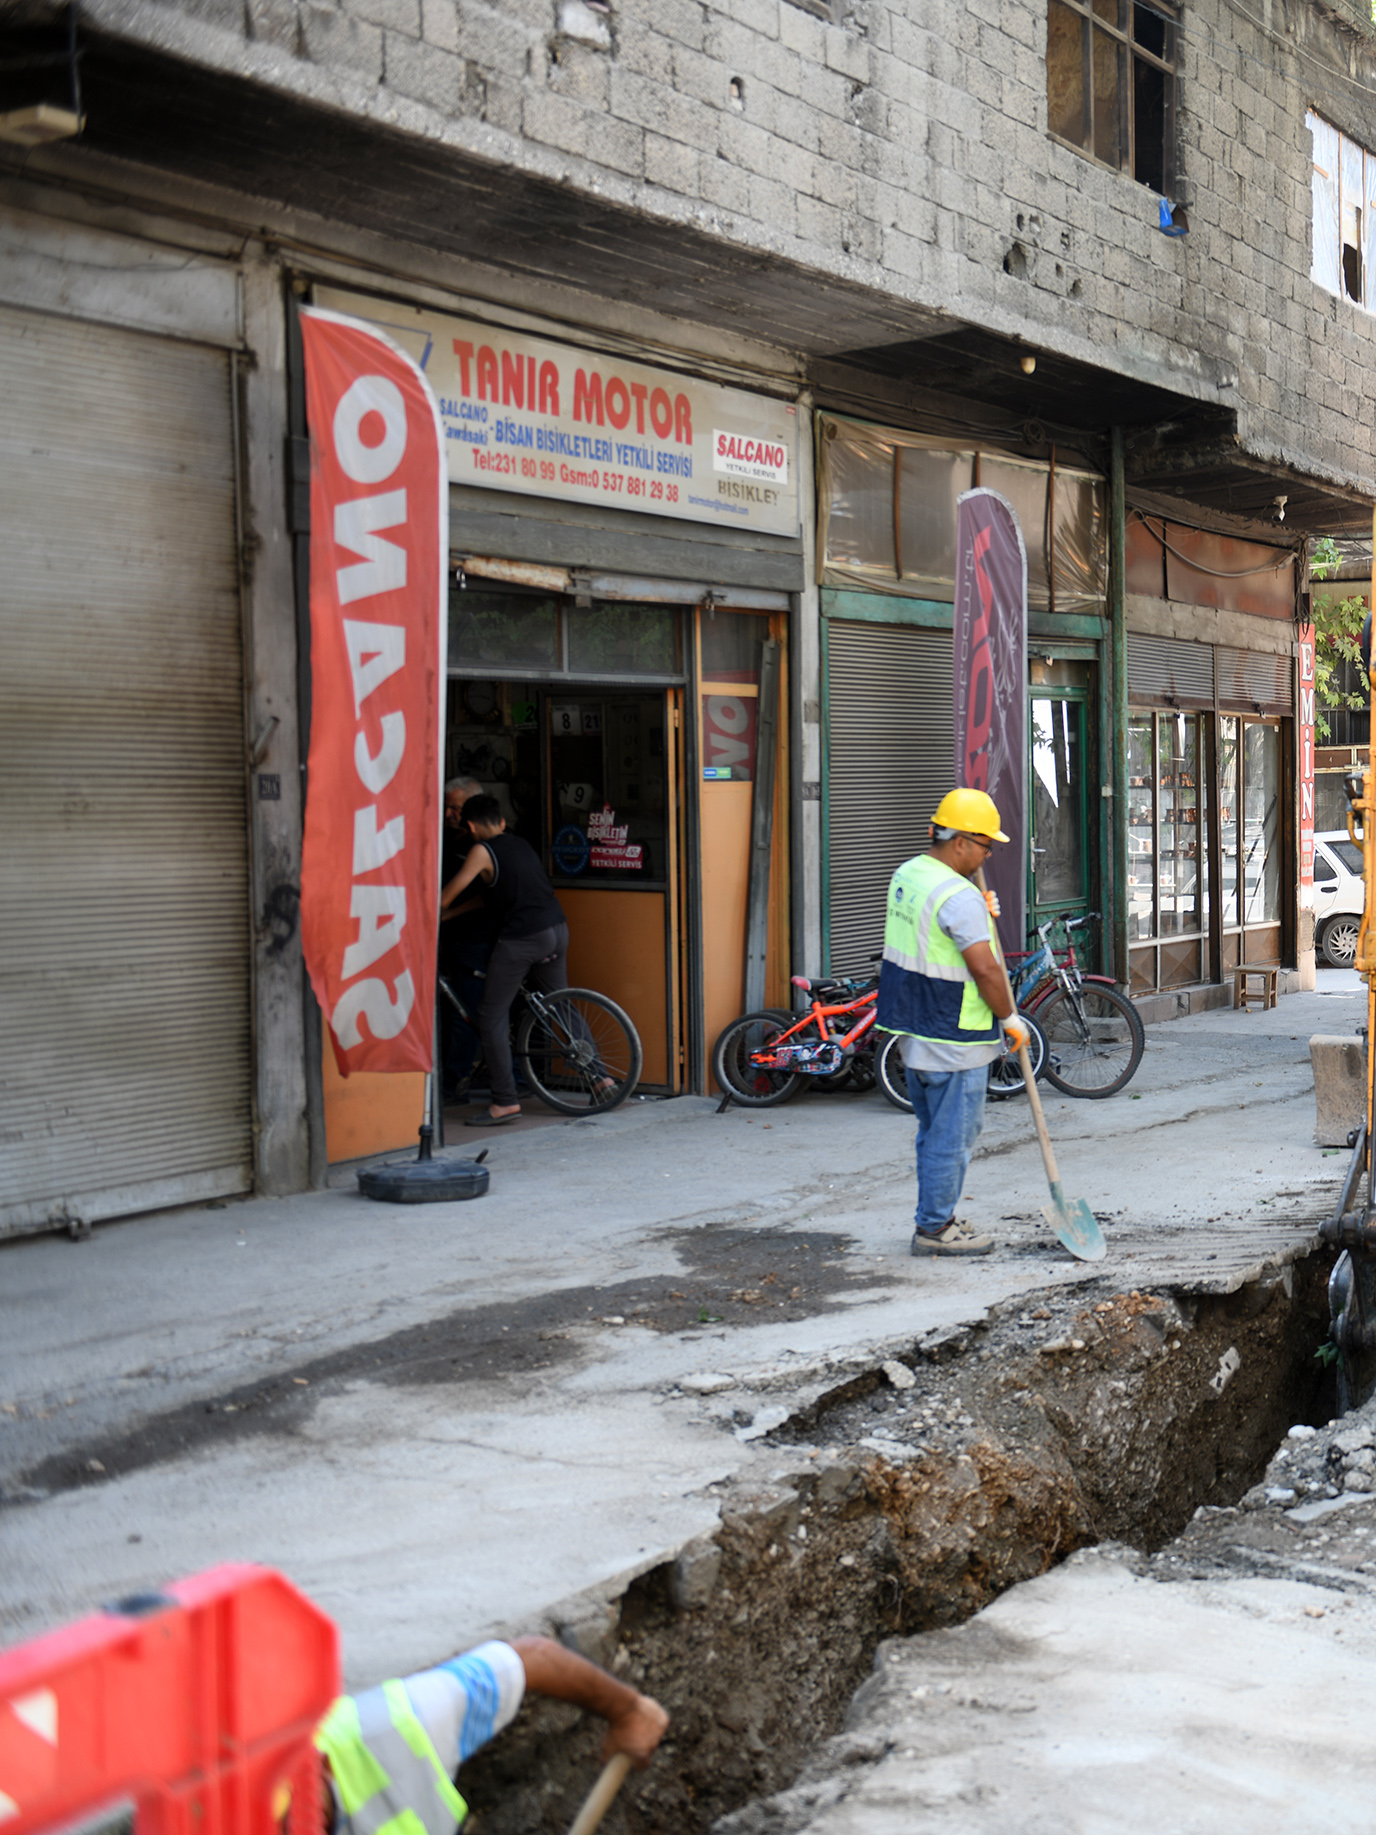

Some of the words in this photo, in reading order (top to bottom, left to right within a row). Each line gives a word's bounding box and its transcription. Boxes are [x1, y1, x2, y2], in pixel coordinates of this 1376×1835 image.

[452, 338, 560, 417] TANIR
[573, 367, 693, 446] MOTOR
[439, 397, 488, 423] SALCANO
[443, 421, 488, 446] awasaki
[717, 434, 784, 469] SALCANO
[472, 448, 517, 475] Tel:231
[521, 457, 537, 478] 80
[540, 461, 556, 481] 99
[560, 463, 599, 489] Gsm:0
[602, 472, 623, 493] 537
[627, 476, 646, 497] 881
[650, 480, 664, 500] 29
[666, 484, 679, 503] 38
